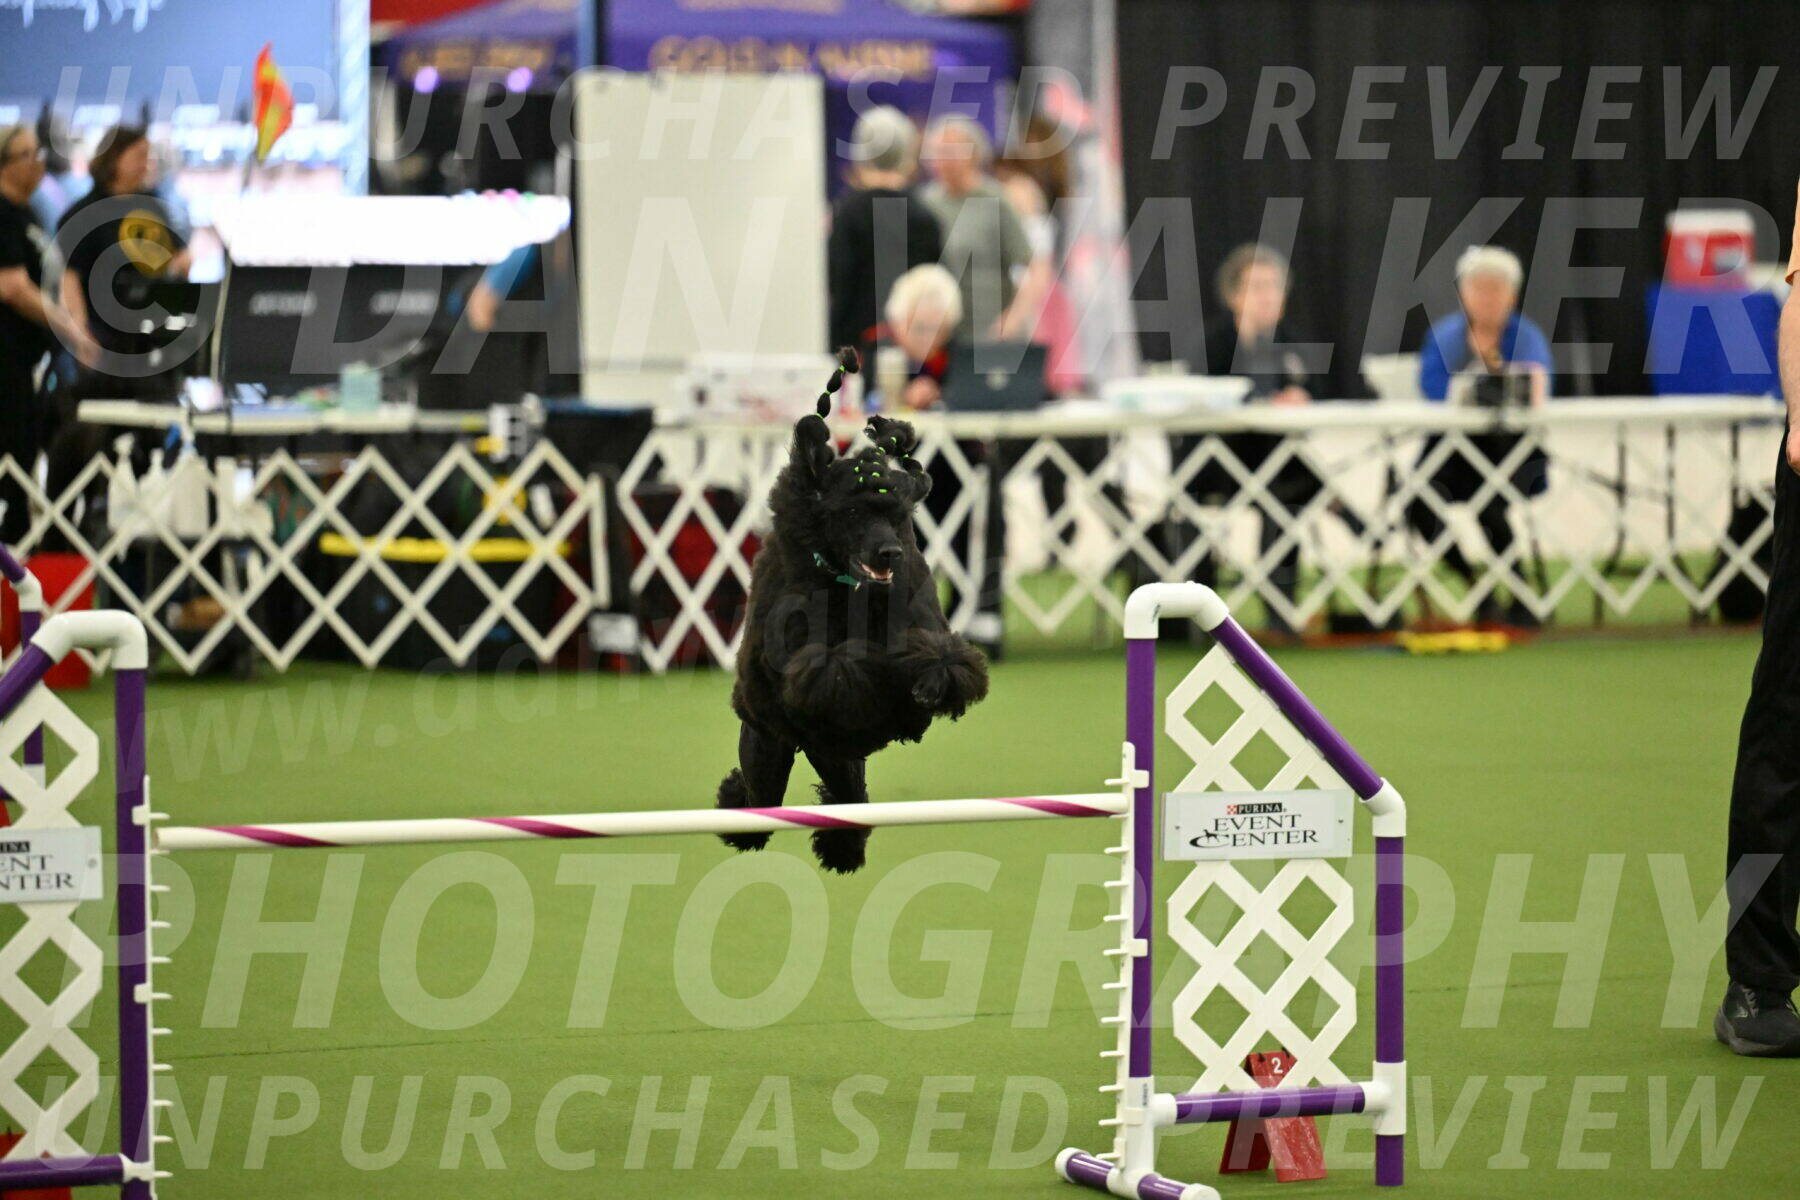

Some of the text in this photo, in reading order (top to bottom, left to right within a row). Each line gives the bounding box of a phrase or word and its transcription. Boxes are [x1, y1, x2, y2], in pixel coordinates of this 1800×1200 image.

[1237, 803, 1282, 814] PURINA
[1214, 815, 1302, 832] EVENT
[1189, 829, 1319, 848] CENTER
[1271, 1057, 1284, 1074] 2
